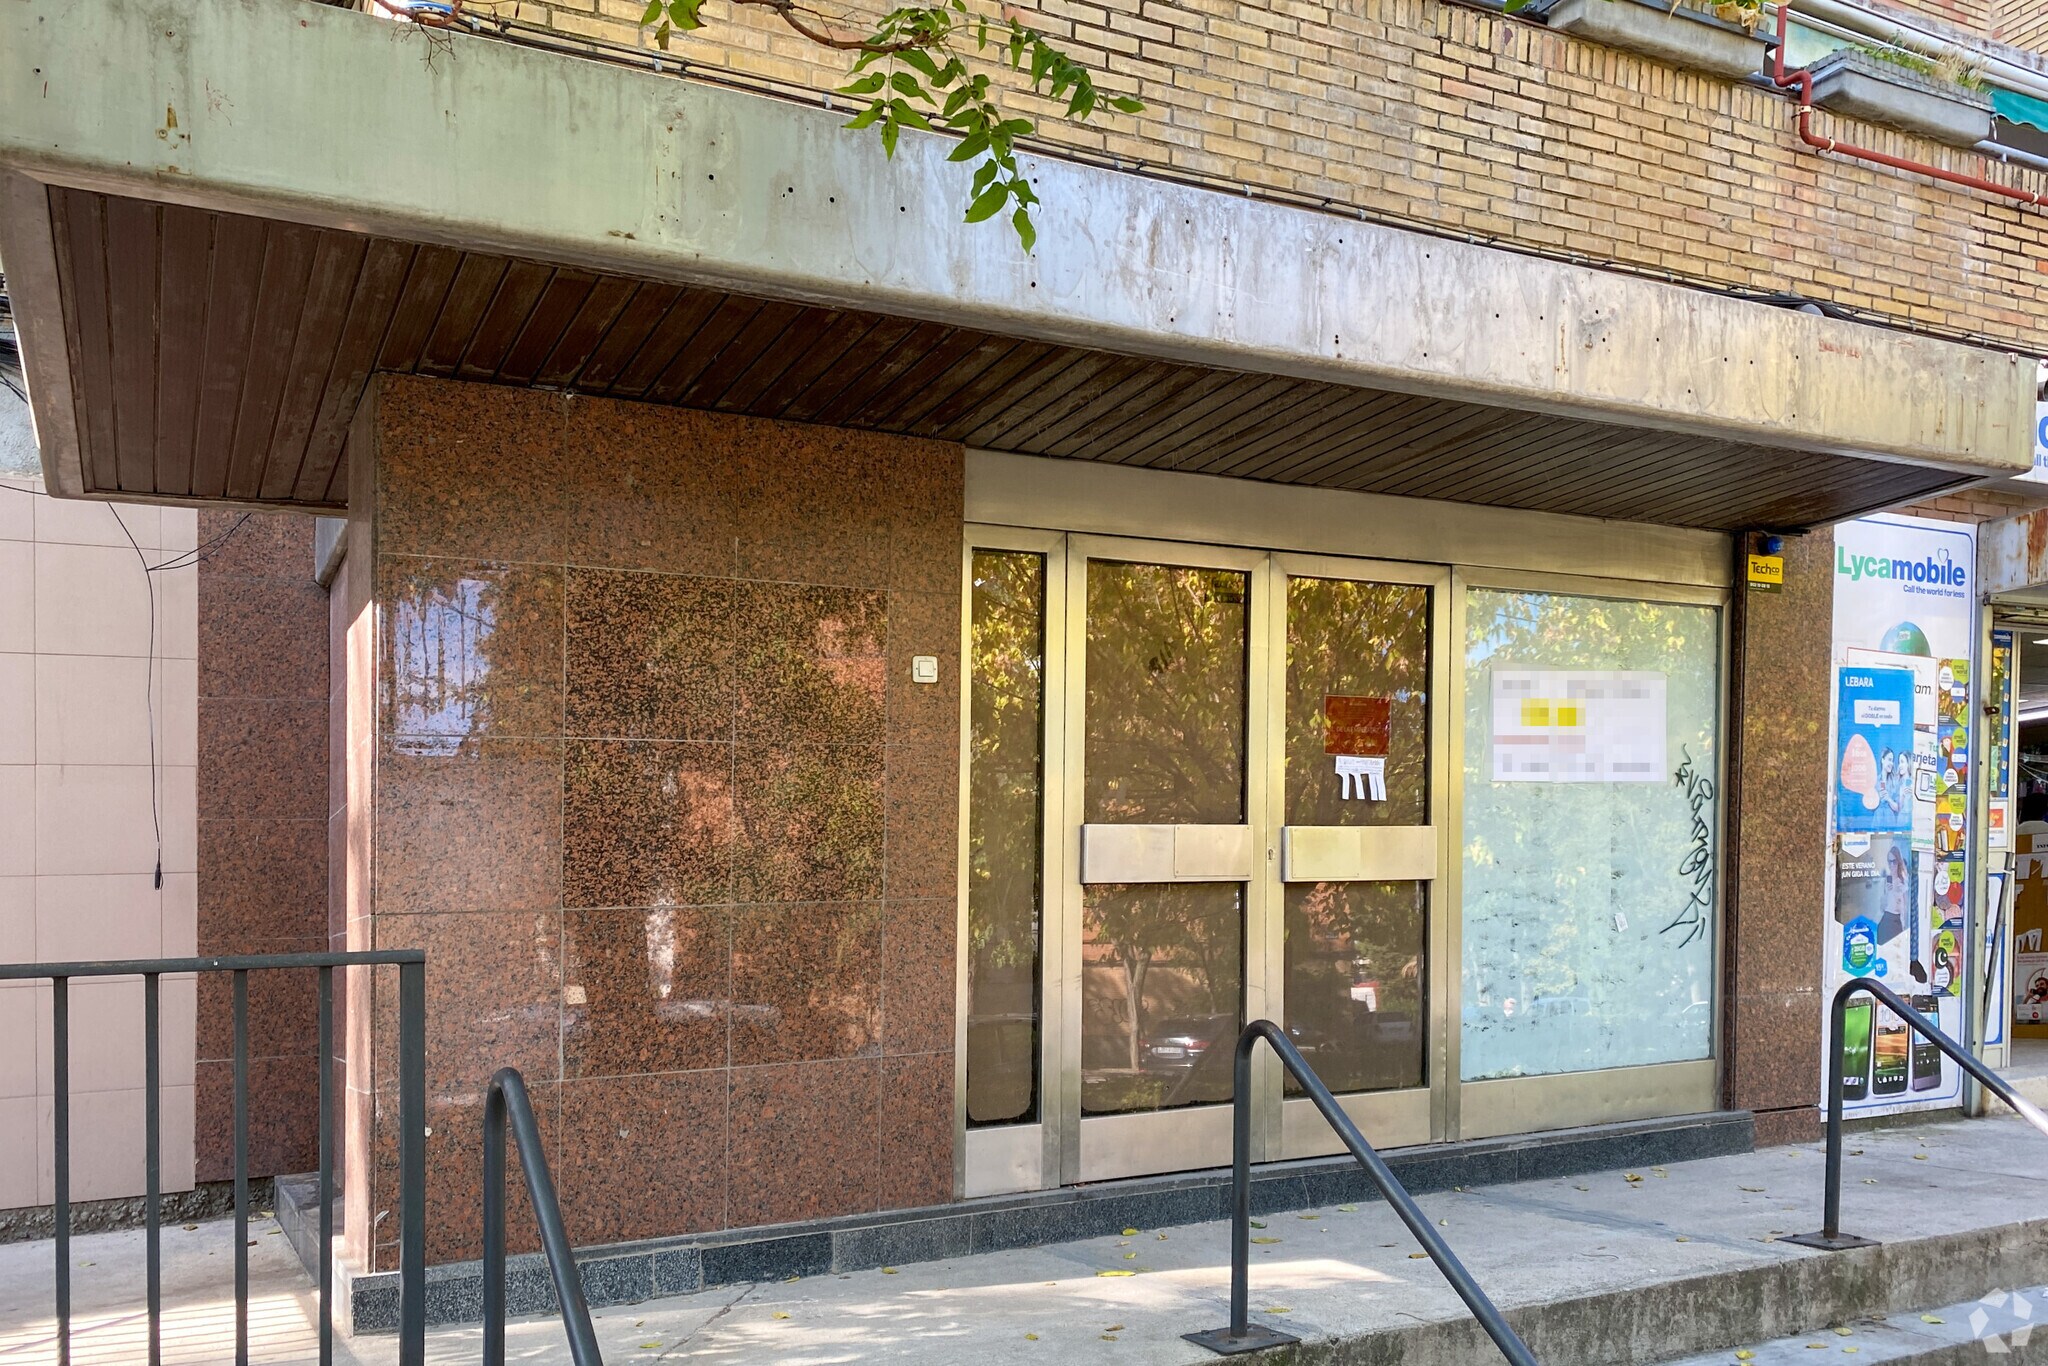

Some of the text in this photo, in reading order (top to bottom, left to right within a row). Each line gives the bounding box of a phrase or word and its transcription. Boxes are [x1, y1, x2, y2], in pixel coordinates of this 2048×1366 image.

[1838, 546, 1966, 587] Lycamobile
[1903, 584, 1965, 599] Call the world for less
[1845, 676, 1874, 688] LEBARA
[1914, 684, 1932, 695] am
[1913, 752, 1936, 768] arjeta
